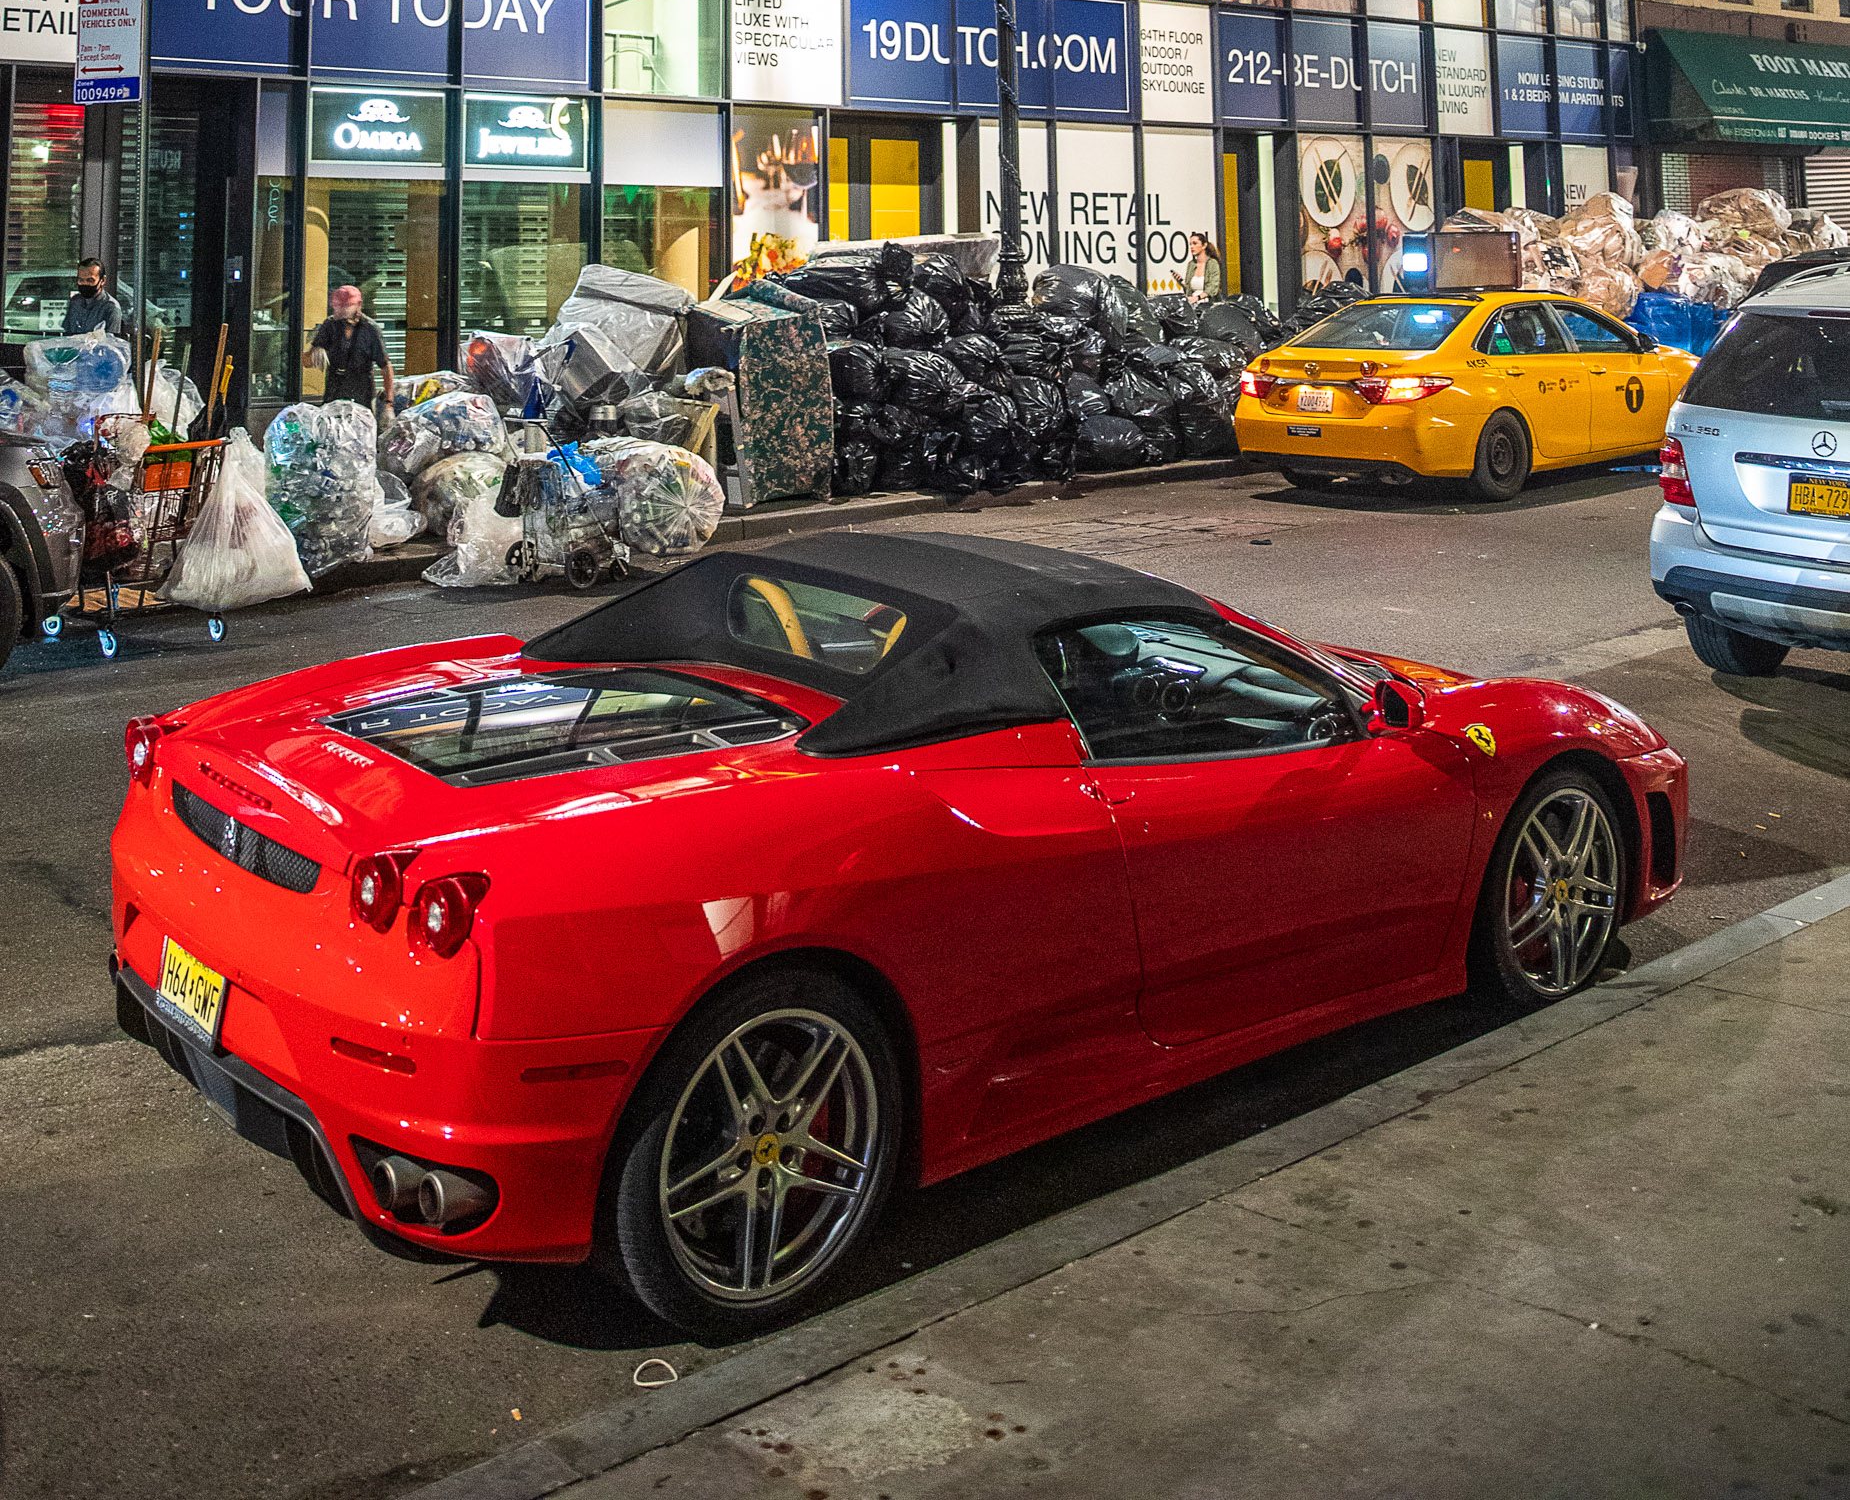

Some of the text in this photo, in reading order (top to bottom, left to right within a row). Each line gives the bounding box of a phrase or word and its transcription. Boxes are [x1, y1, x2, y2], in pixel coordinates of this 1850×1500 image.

[81, 7, 129, 18] COMMERCIAL
[735, 11, 809, 29] LUXE WITH
[2, 7, 77, 35] ETAIL
[81, 18, 137, 29] VEHICLES ONLY
[1140, 29, 1203, 45] 64TH FLOOR
[862, 18, 1117, 75] 19DUTCH.COM
[1141, 46, 1181, 60] INDOOR
[735, 52, 779, 67] VIEWS
[1438, 50, 1456, 62] NEW
[1142, 62, 1193, 76] OUTDOOR
[1227, 48, 1418, 94] 212-BE-DUTCH
[1436, 65, 1487, 82] STANDARD
[1749, 53, 1850, 79] FOOT MART
[1142, 79, 1205, 95] SKYLOUNGE
[1518, 72, 1540, 86] NOW
[1541, 74, 1576, 88] LESING
[77, 87, 116, 101] 100949
[1449, 84, 1487, 98] LUXURY
[1504, 88, 1624, 107] 1 & 2 BEDRM APARTMTS
[1438, 101, 1468, 114] LIVING
[1809, 131, 1840, 141] DOCKERS
[1565, 184, 1587, 200] NEW
[986, 190, 1171, 227] NEW RETAIL
[1127, 230, 1208, 265] SOO
[1696, 426, 1720, 437] 350
[1829, 480, 1847, 488] YORK
[1794, 485, 1850, 510] HBA 729
